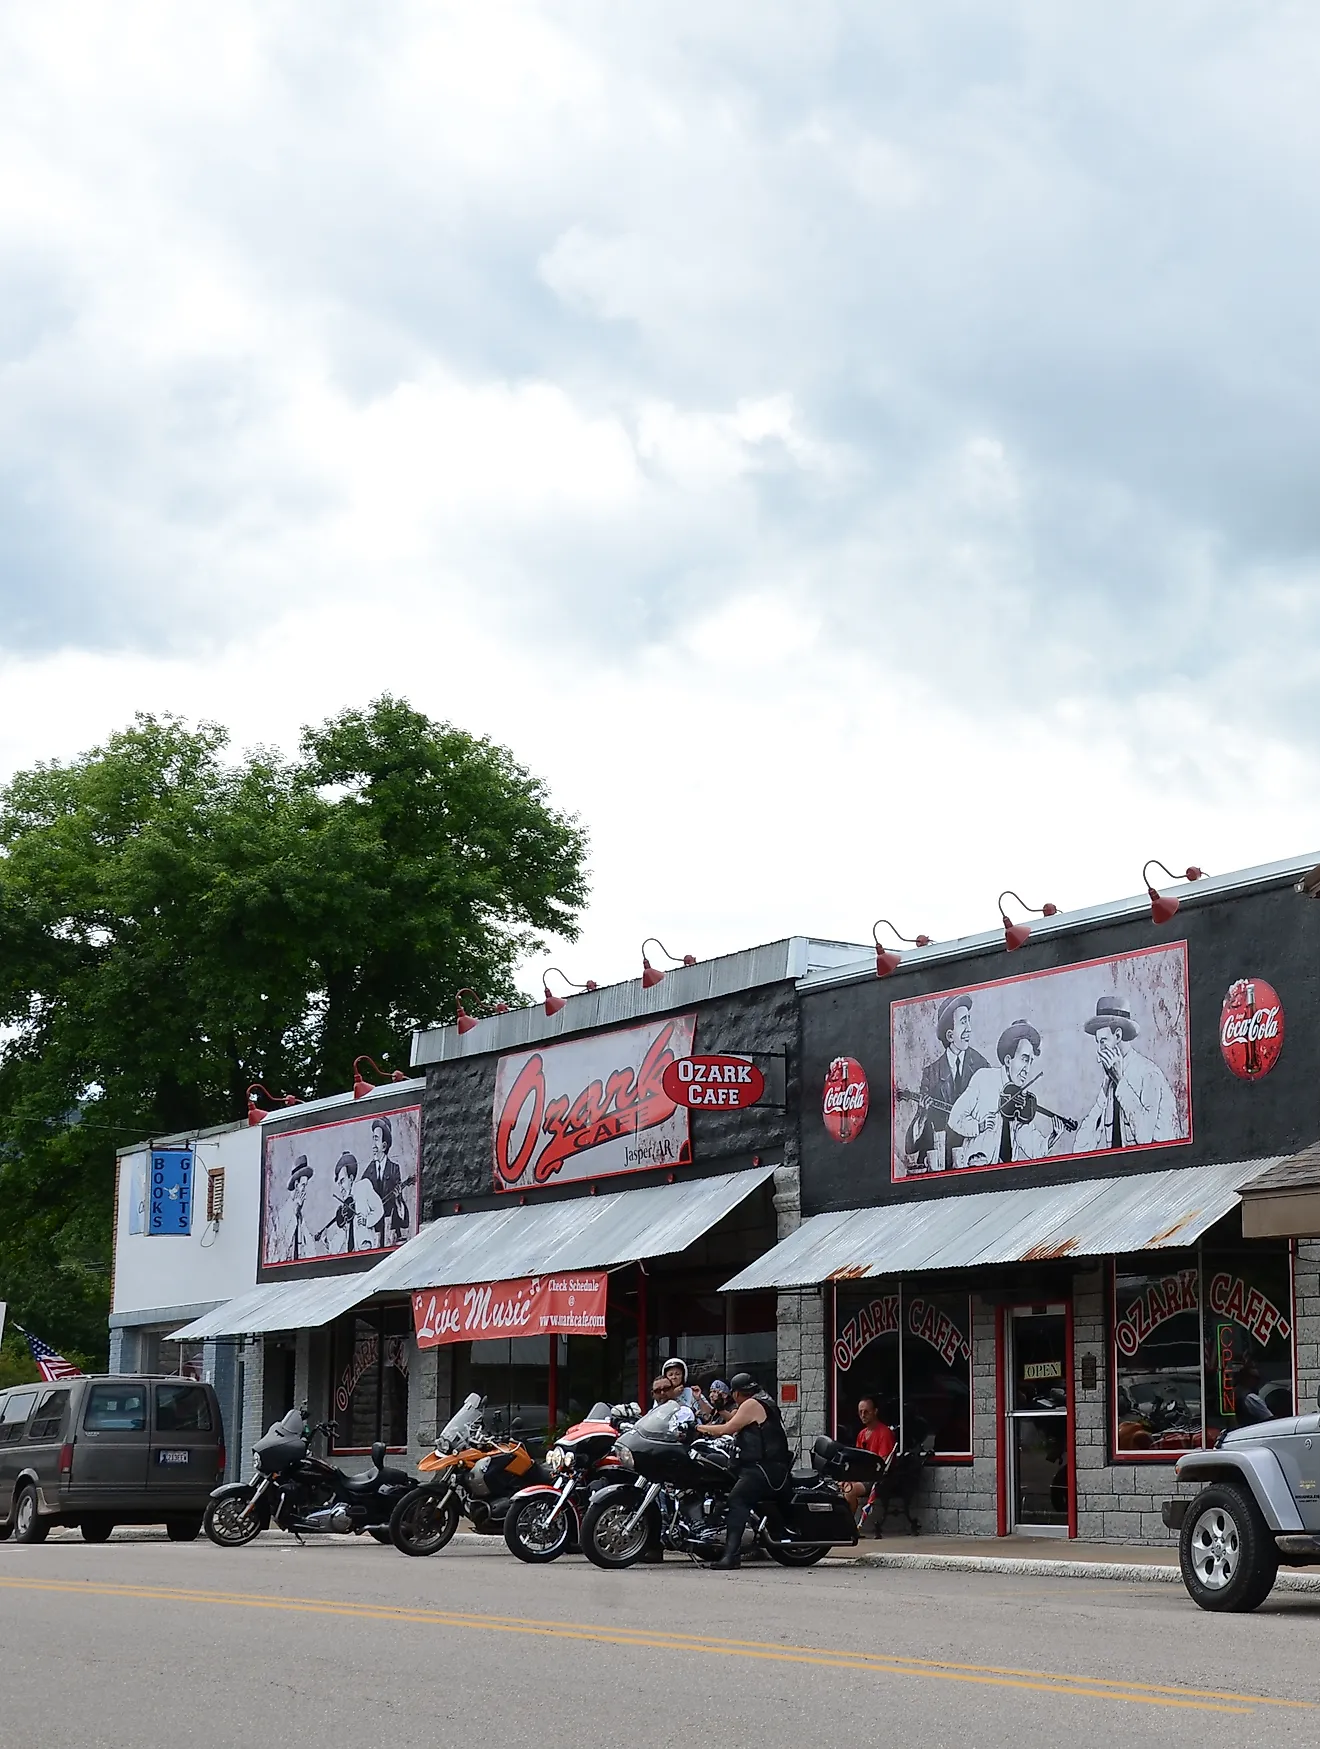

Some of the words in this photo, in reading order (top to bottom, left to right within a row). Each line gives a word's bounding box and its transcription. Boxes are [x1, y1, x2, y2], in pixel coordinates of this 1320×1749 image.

[678, 1060, 752, 1084] OZARK
[688, 1085, 740, 1105] CAFE
[496, 1021, 676, 1184] Ozark
[573, 1104, 650, 1149] CAFE
[655, 1139, 675, 1159] AR
[153, 1157, 165, 1229] BOOKS
[178, 1157, 191, 1229] GIFTS
[416, 1295, 461, 1340] Live
[464, 1286, 532, 1331] Music
[548, 1279, 567, 1293] Check
[568, 1279, 600, 1292] Schedule
[1116, 1269, 1199, 1356] OZARK
[834, 1295, 899, 1371] OZARK
[336, 1333, 379, 1412] OZARK
[1027, 1364, 1059, 1378] OPEN
